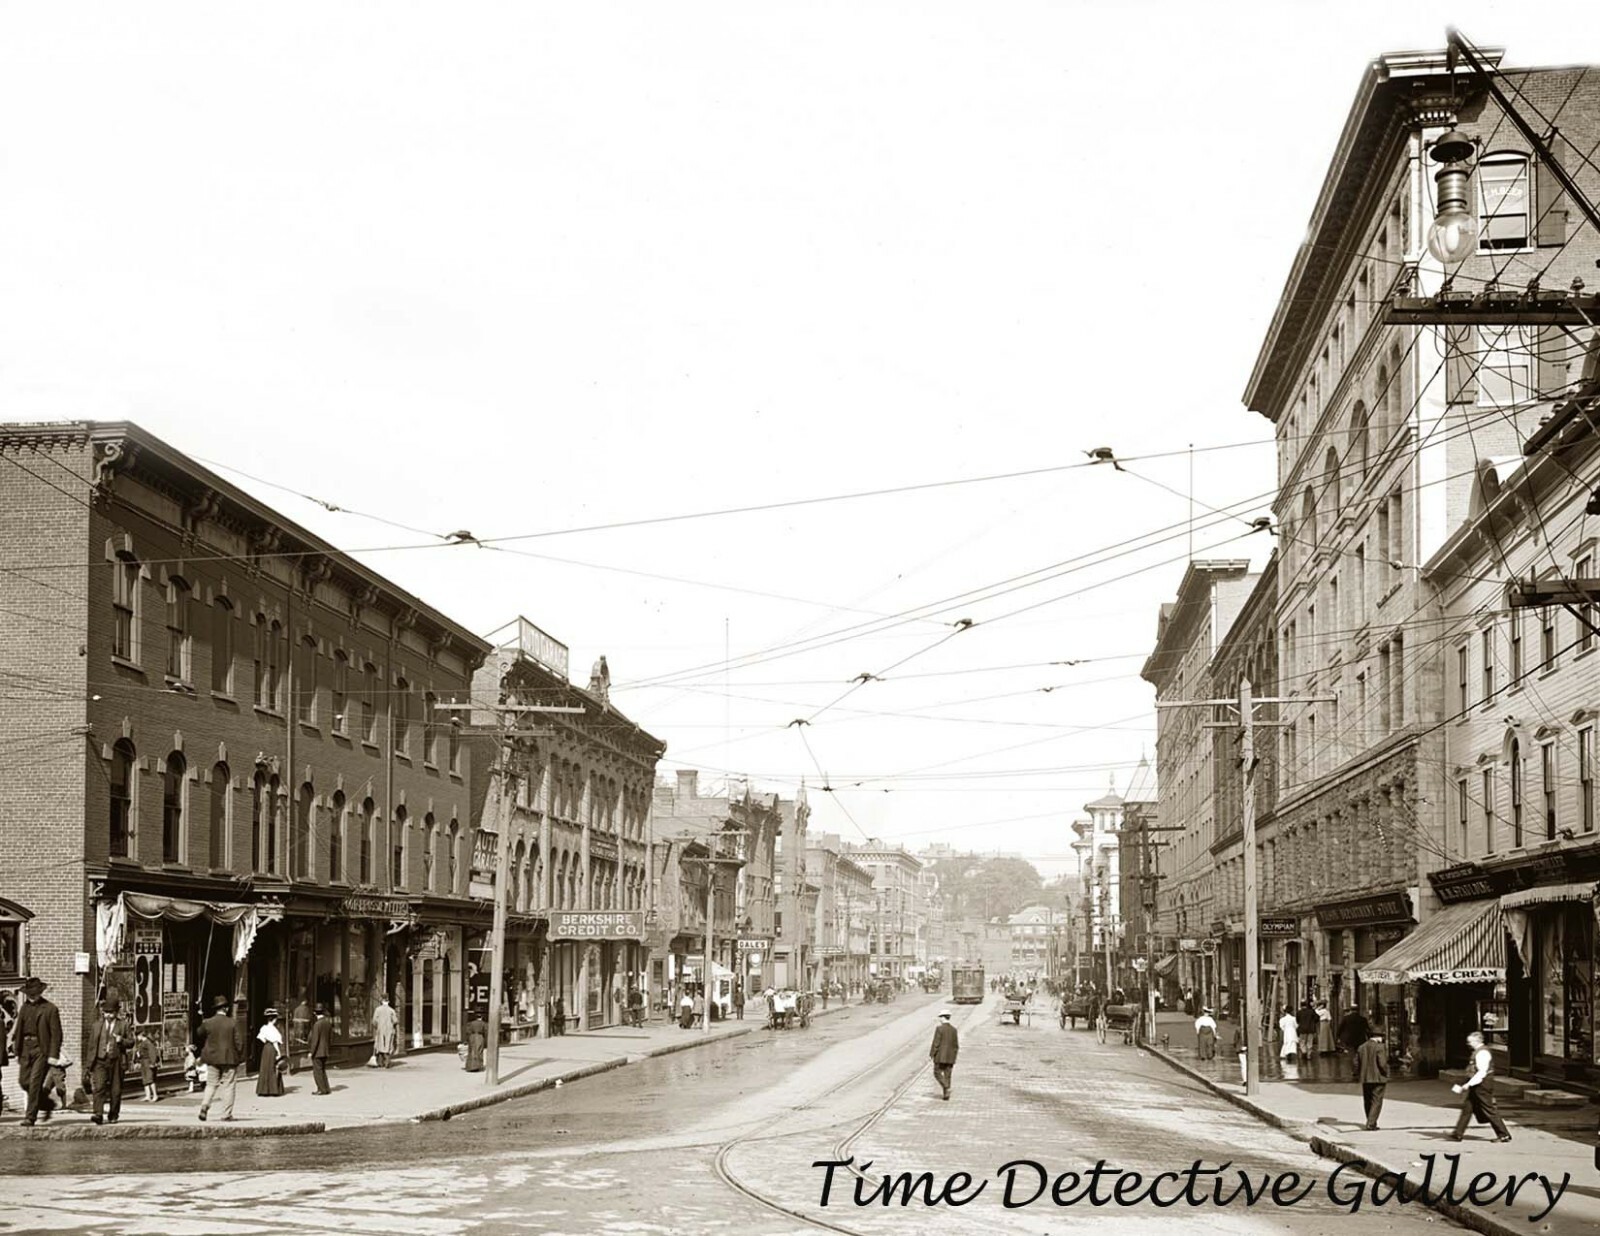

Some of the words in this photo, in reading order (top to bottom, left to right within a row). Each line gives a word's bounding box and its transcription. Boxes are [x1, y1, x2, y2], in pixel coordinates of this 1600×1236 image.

[562, 914, 632, 925] BERKSHIRE
[557, 925, 609, 935] CREDIT
[615, 925, 639, 935] CO.
[1452, 969, 1498, 979] CREAM
[136, 955, 161, 1023] 31
